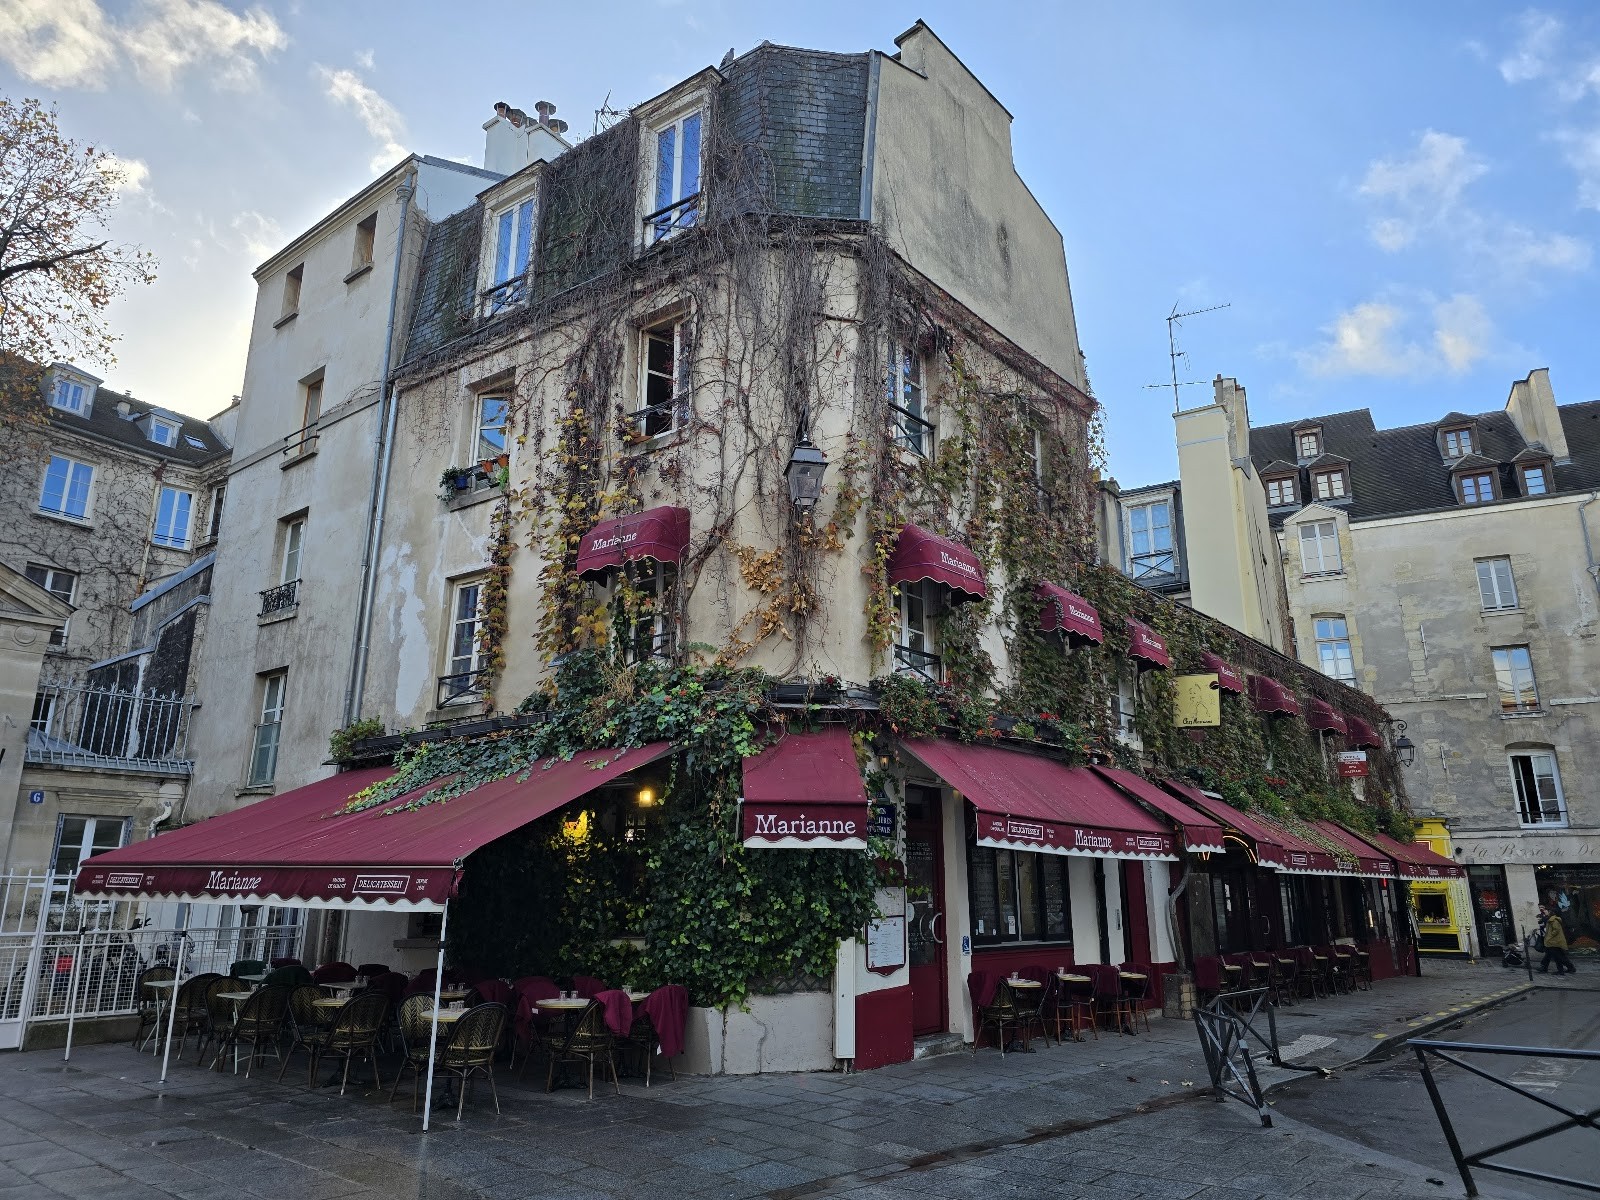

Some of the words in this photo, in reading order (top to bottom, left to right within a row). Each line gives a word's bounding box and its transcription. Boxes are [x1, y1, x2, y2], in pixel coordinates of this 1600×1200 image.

[590, 531, 638, 551] Marianne
[941, 551, 977, 575] Marianne
[33, 792, 41, 803] 6
[754, 813, 857, 834] Marianne
[1074, 829, 1113, 849] Marianne
[204, 870, 262, 890] Marianne
[358, 879, 404, 889] DELICATESSEN
